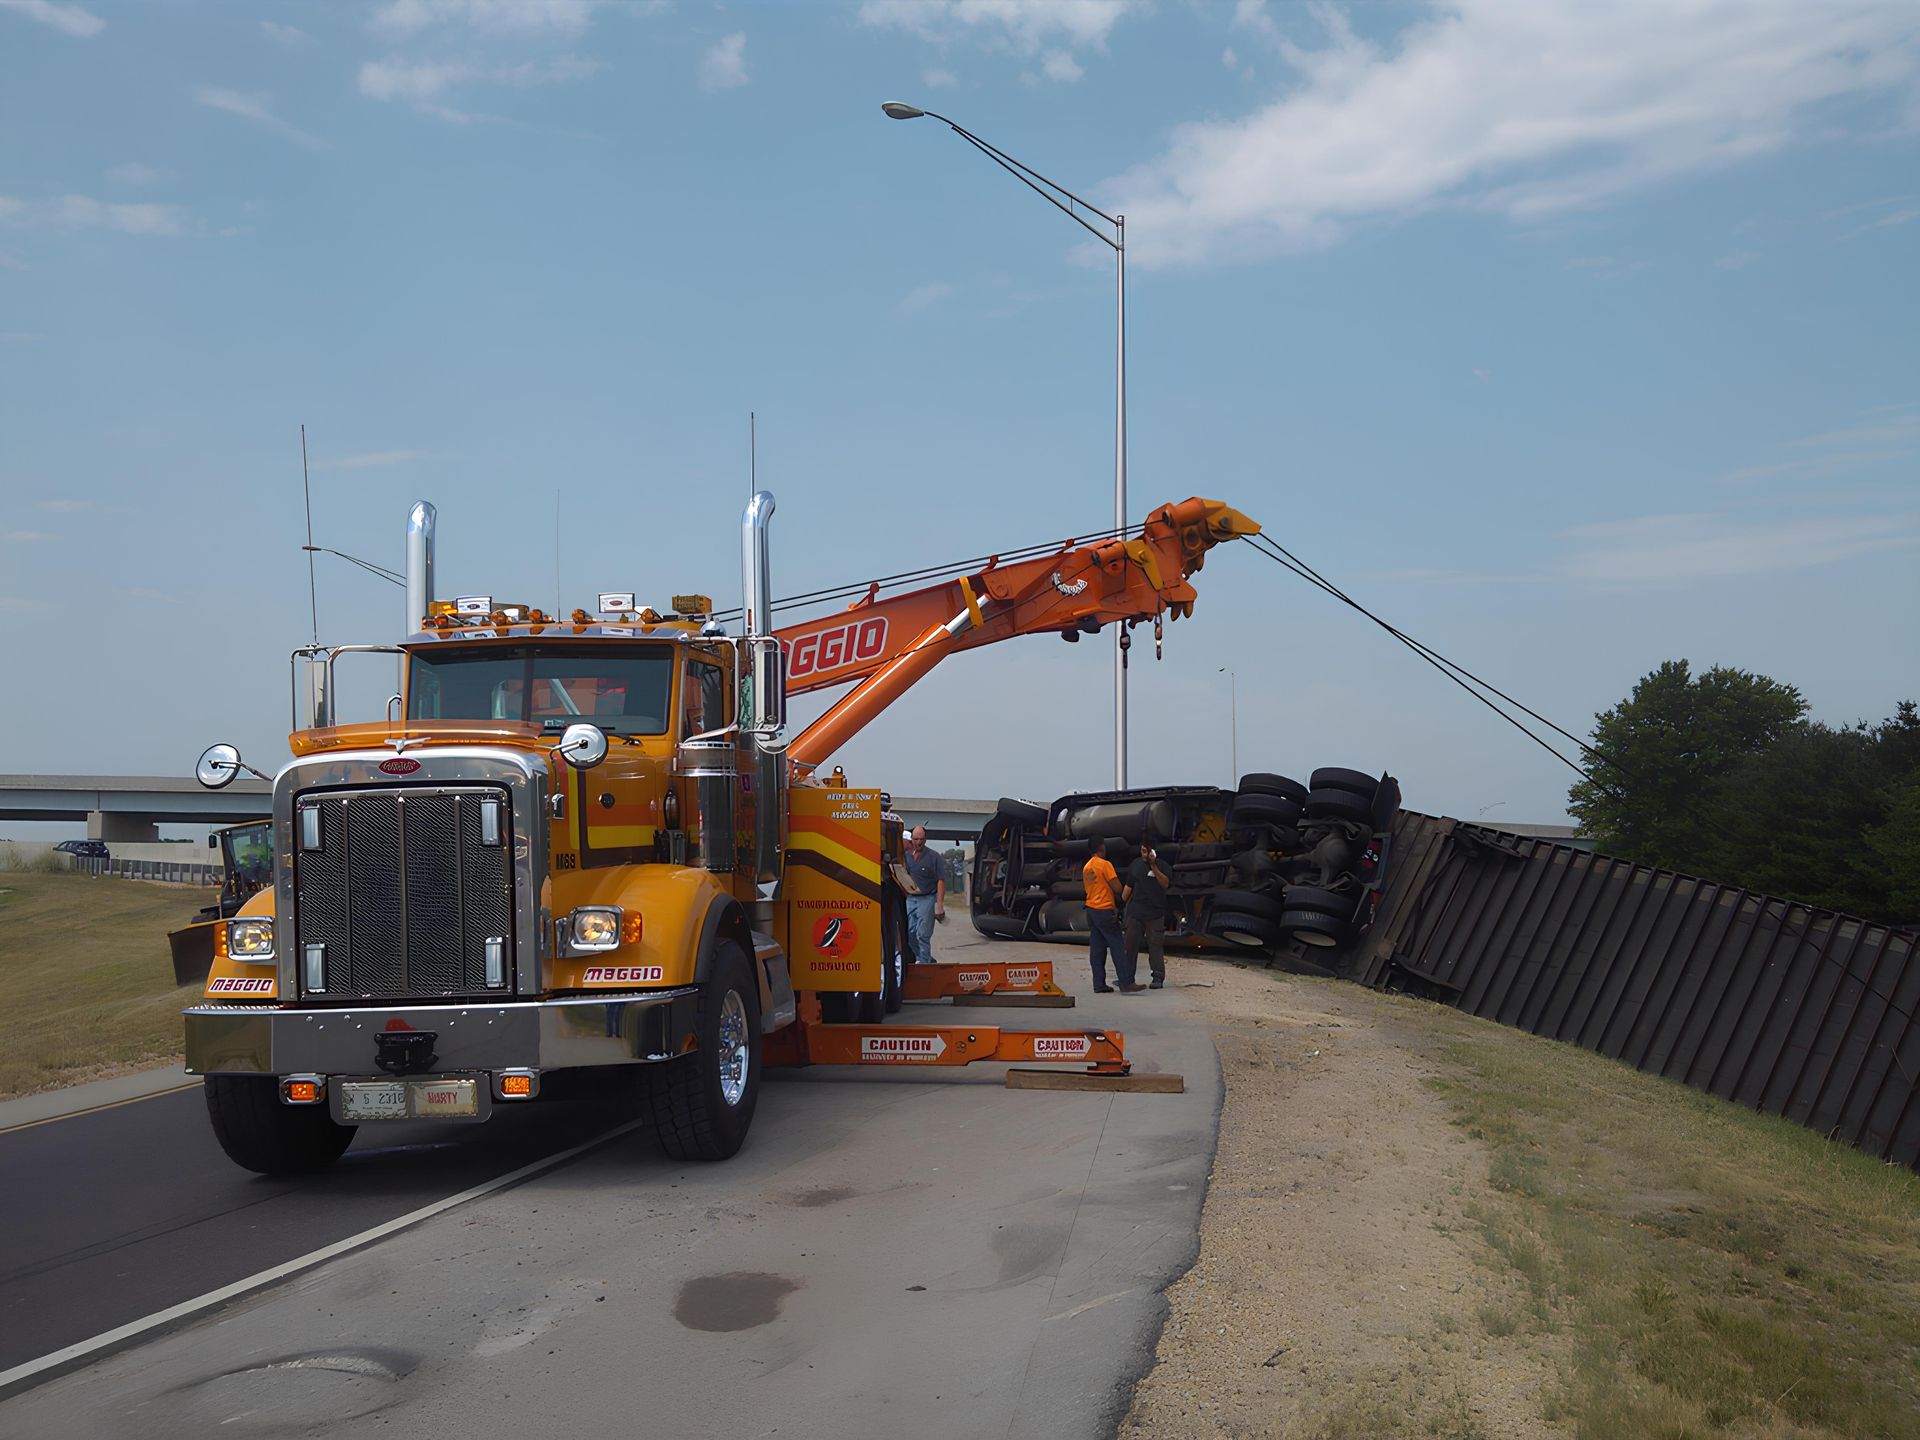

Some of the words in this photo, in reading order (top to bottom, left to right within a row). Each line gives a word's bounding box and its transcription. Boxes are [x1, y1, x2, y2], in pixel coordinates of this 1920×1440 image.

[783, 616, 889, 680] GGIO
[584, 967, 662, 981] MAGGIO
[209, 979, 274, 991] MAGGIO
[869, 1040, 932, 1051] CAUTION
[1037, 1040, 1085, 1051] CAUTION
